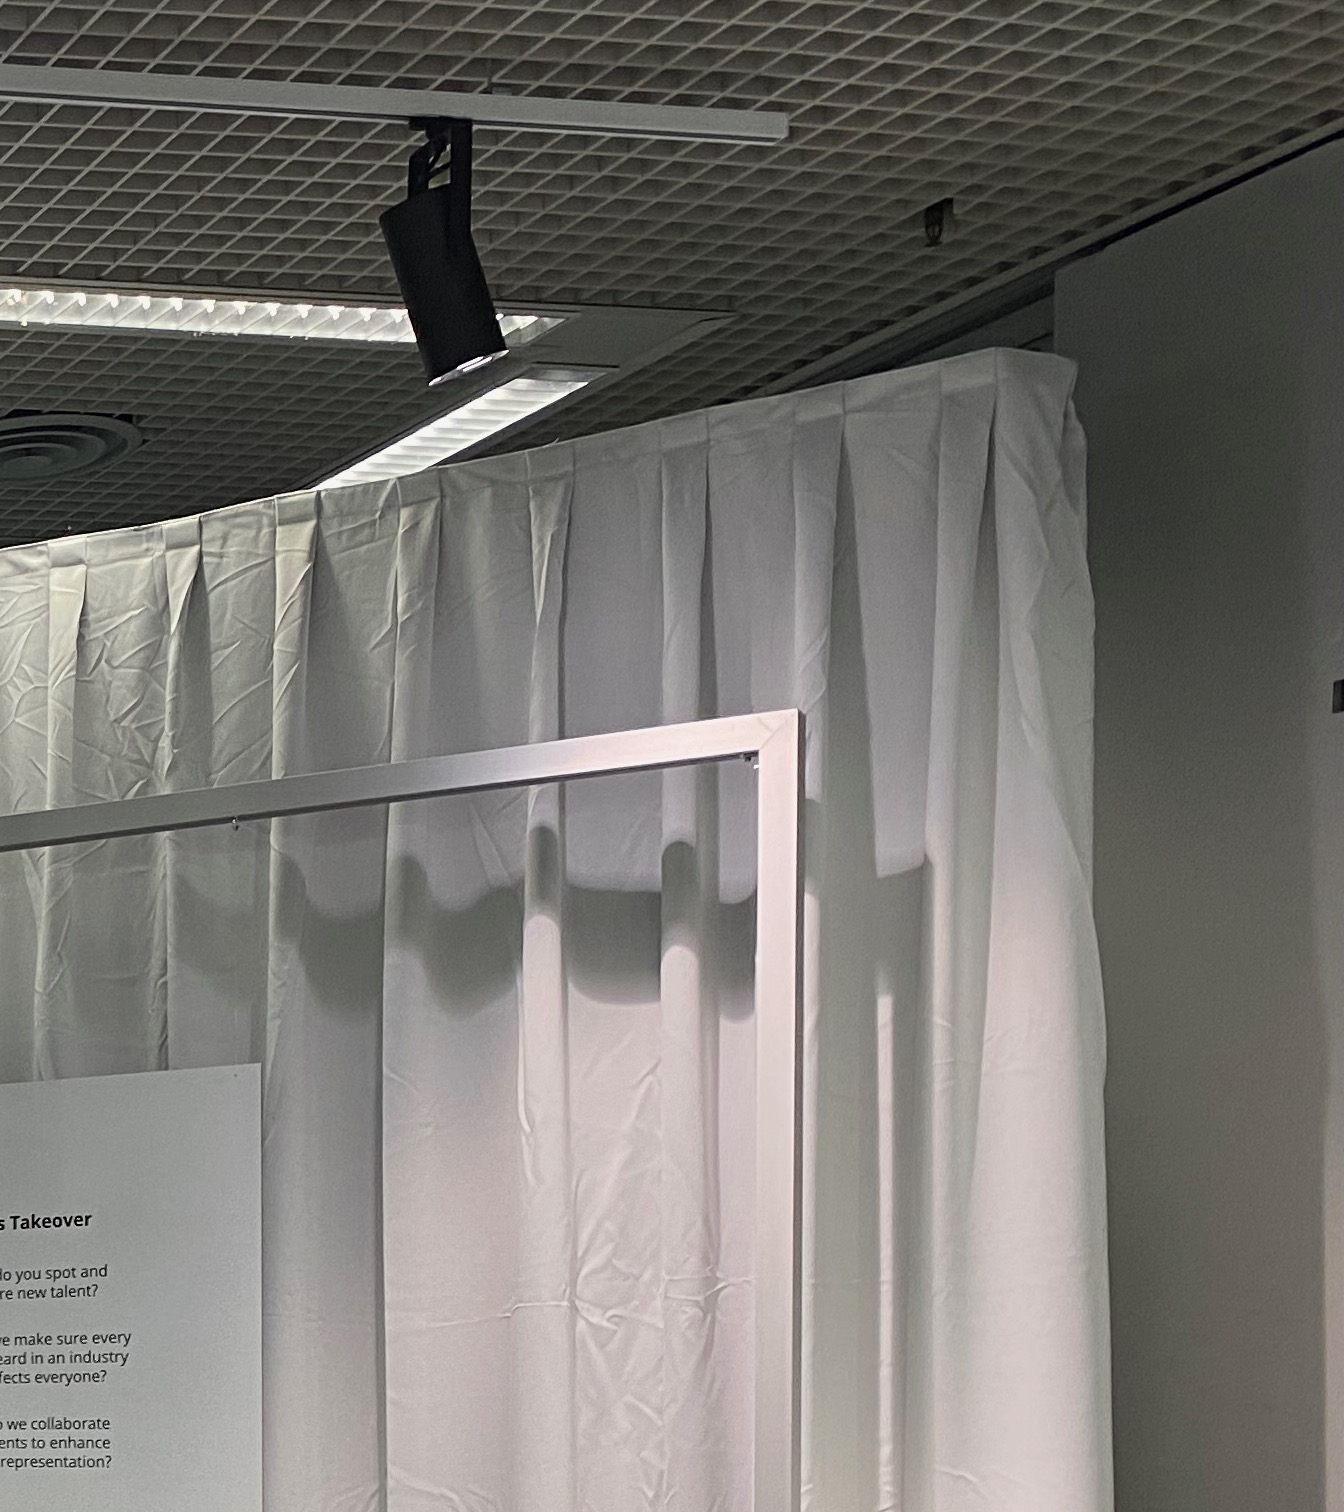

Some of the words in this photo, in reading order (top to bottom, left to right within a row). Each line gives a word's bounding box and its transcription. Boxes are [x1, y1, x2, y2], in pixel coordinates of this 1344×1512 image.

[10, 1213, 92, 1230] Takeover
[15, 1269, 42, 1284] you
[45, 1267, 77, 1282] spot
[80, 1264, 108, 1278] and
[17, 1287, 47, 1299] new
[50, 1284, 99, 1298] talent?
[14, 1332, 53, 1346] make
[56, 1334, 88, 1345] sure
[92, 1332, 132, 1347] every
[31, 1351, 44, 1364] in
[47, 1353, 66, 1364] an
[69, 1349, 129, 1366] industry
[34, 1369, 107, 1386] everyone?
[7, 1420, 27, 1430] we
[30, 1416, 111, 1430] collaborate
[31, 1437, 46, 1449] to
[49, 1436, 111, 1449] enhance
[0, 1453, 112, 1470] representation?
